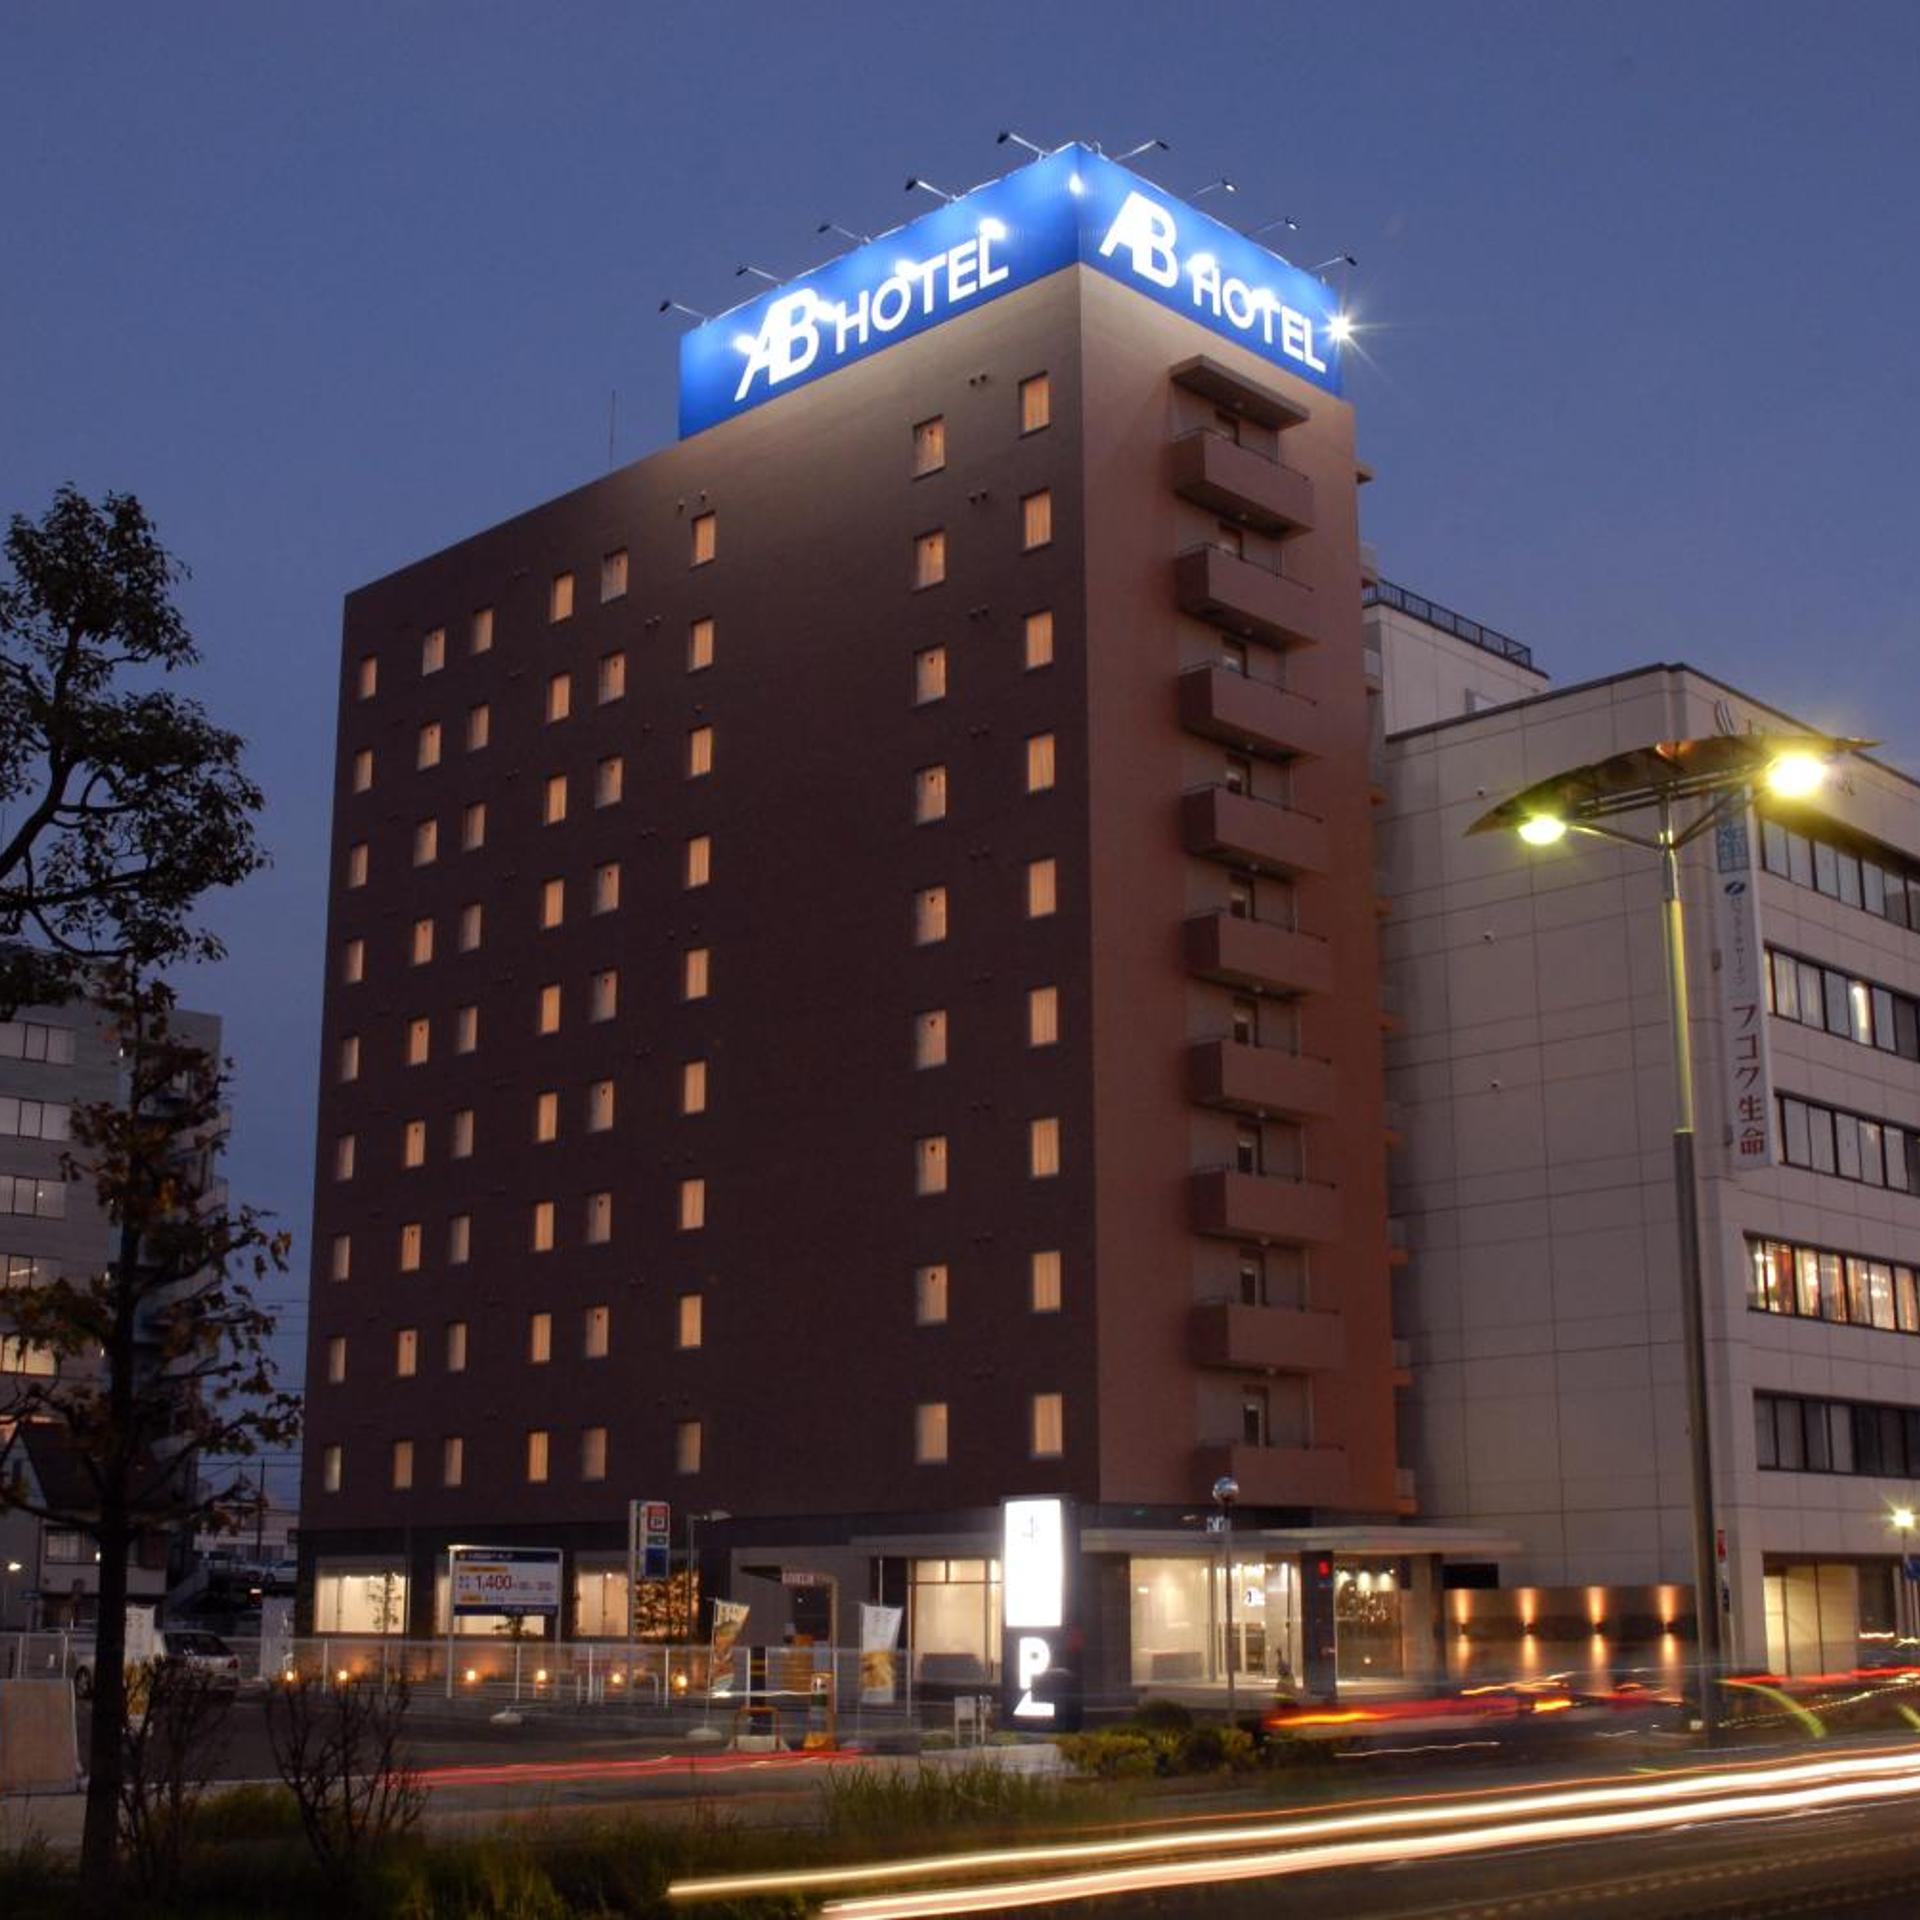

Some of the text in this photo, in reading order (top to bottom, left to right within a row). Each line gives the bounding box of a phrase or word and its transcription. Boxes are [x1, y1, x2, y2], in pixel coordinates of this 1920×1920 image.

[734, 232, 1009, 400] AB HOTEL
[1099, 191, 1326, 372] AB HOTEL
[1733, 1004, 1765, 1156] フコク生命
